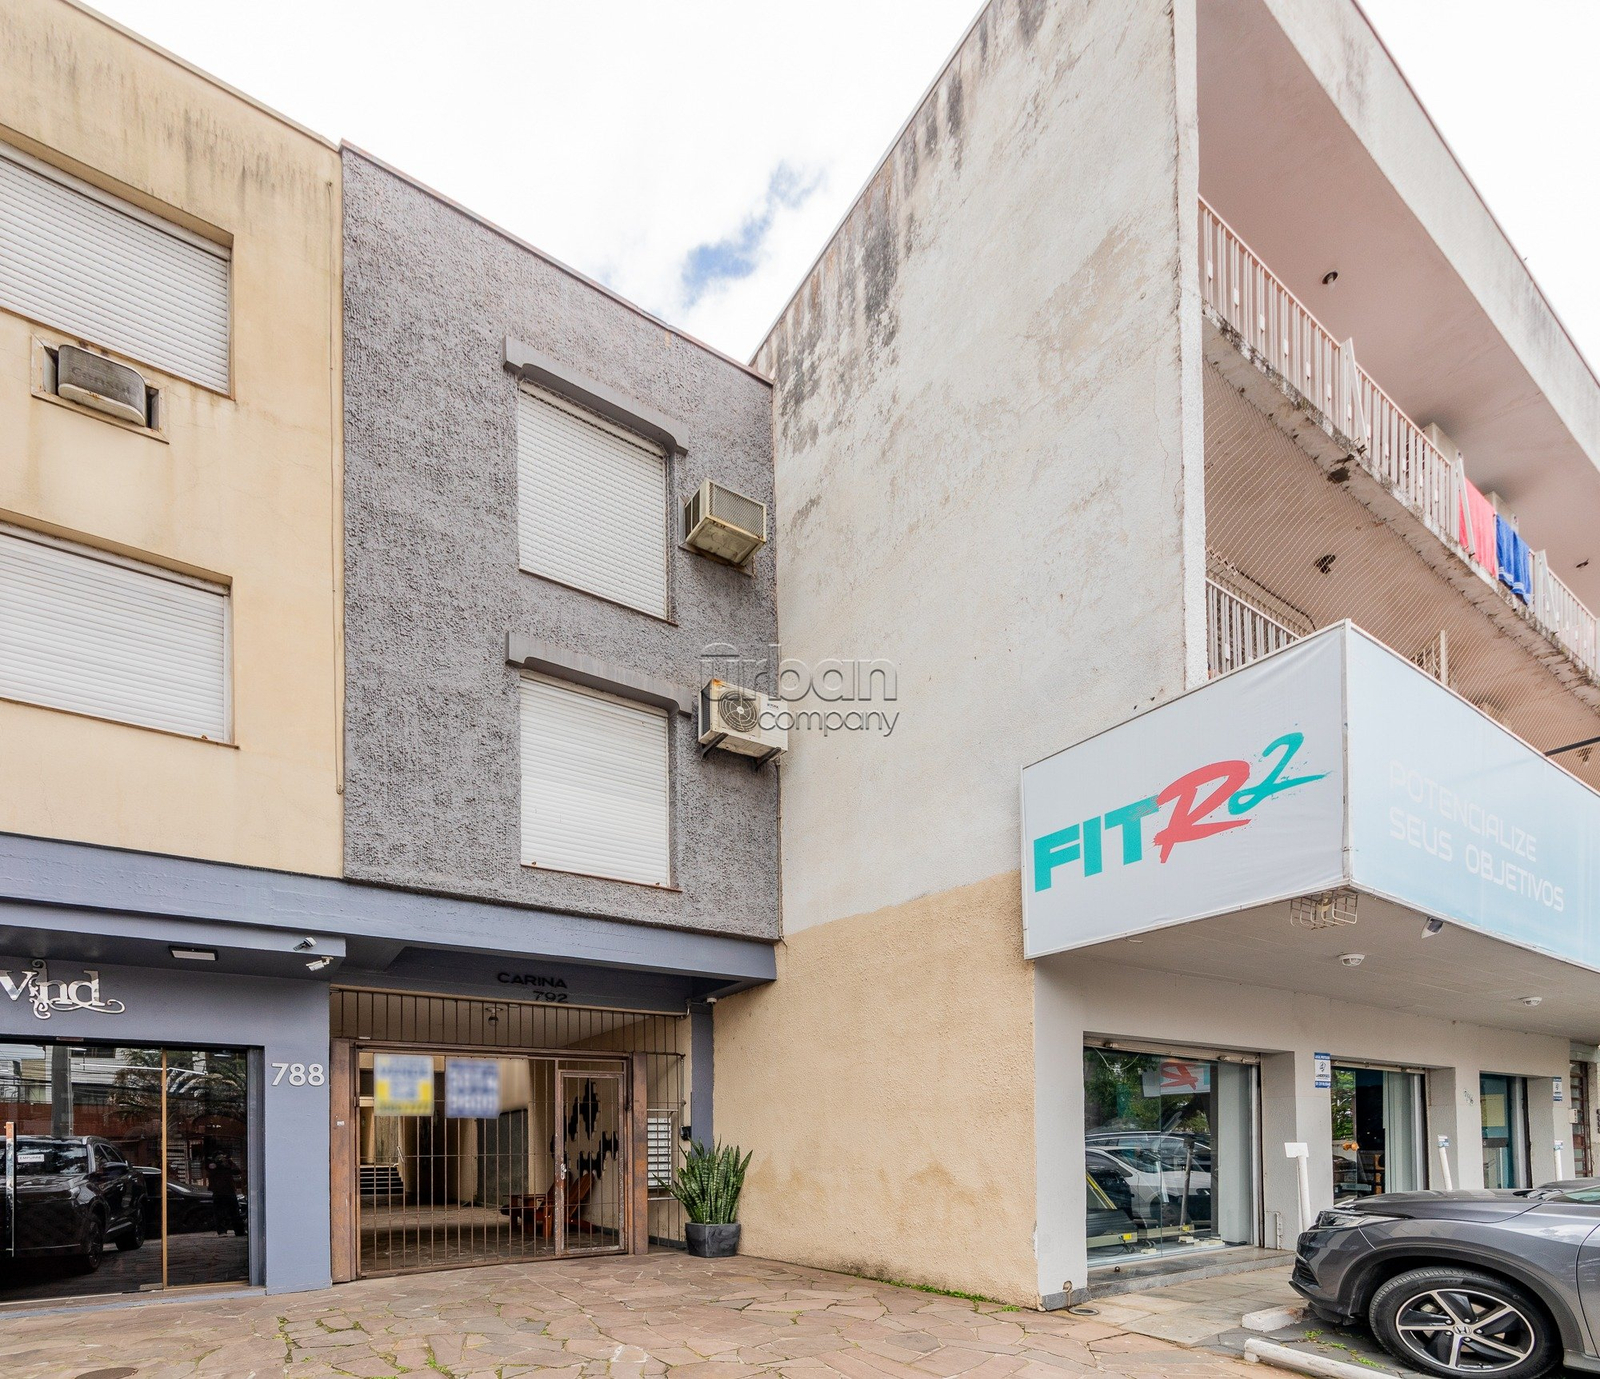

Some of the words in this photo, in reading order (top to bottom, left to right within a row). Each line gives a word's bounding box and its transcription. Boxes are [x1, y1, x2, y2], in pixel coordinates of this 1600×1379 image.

[1389, 759, 1538, 863] POTENCIALIZE
[1389, 806, 1454, 863] SEUS
[1465, 842, 1564, 913] OBJETIVOS
[497, 972, 568, 989] CARINA
[532, 990, 569, 1004] 792
[271, 1062, 325, 1087] 788
